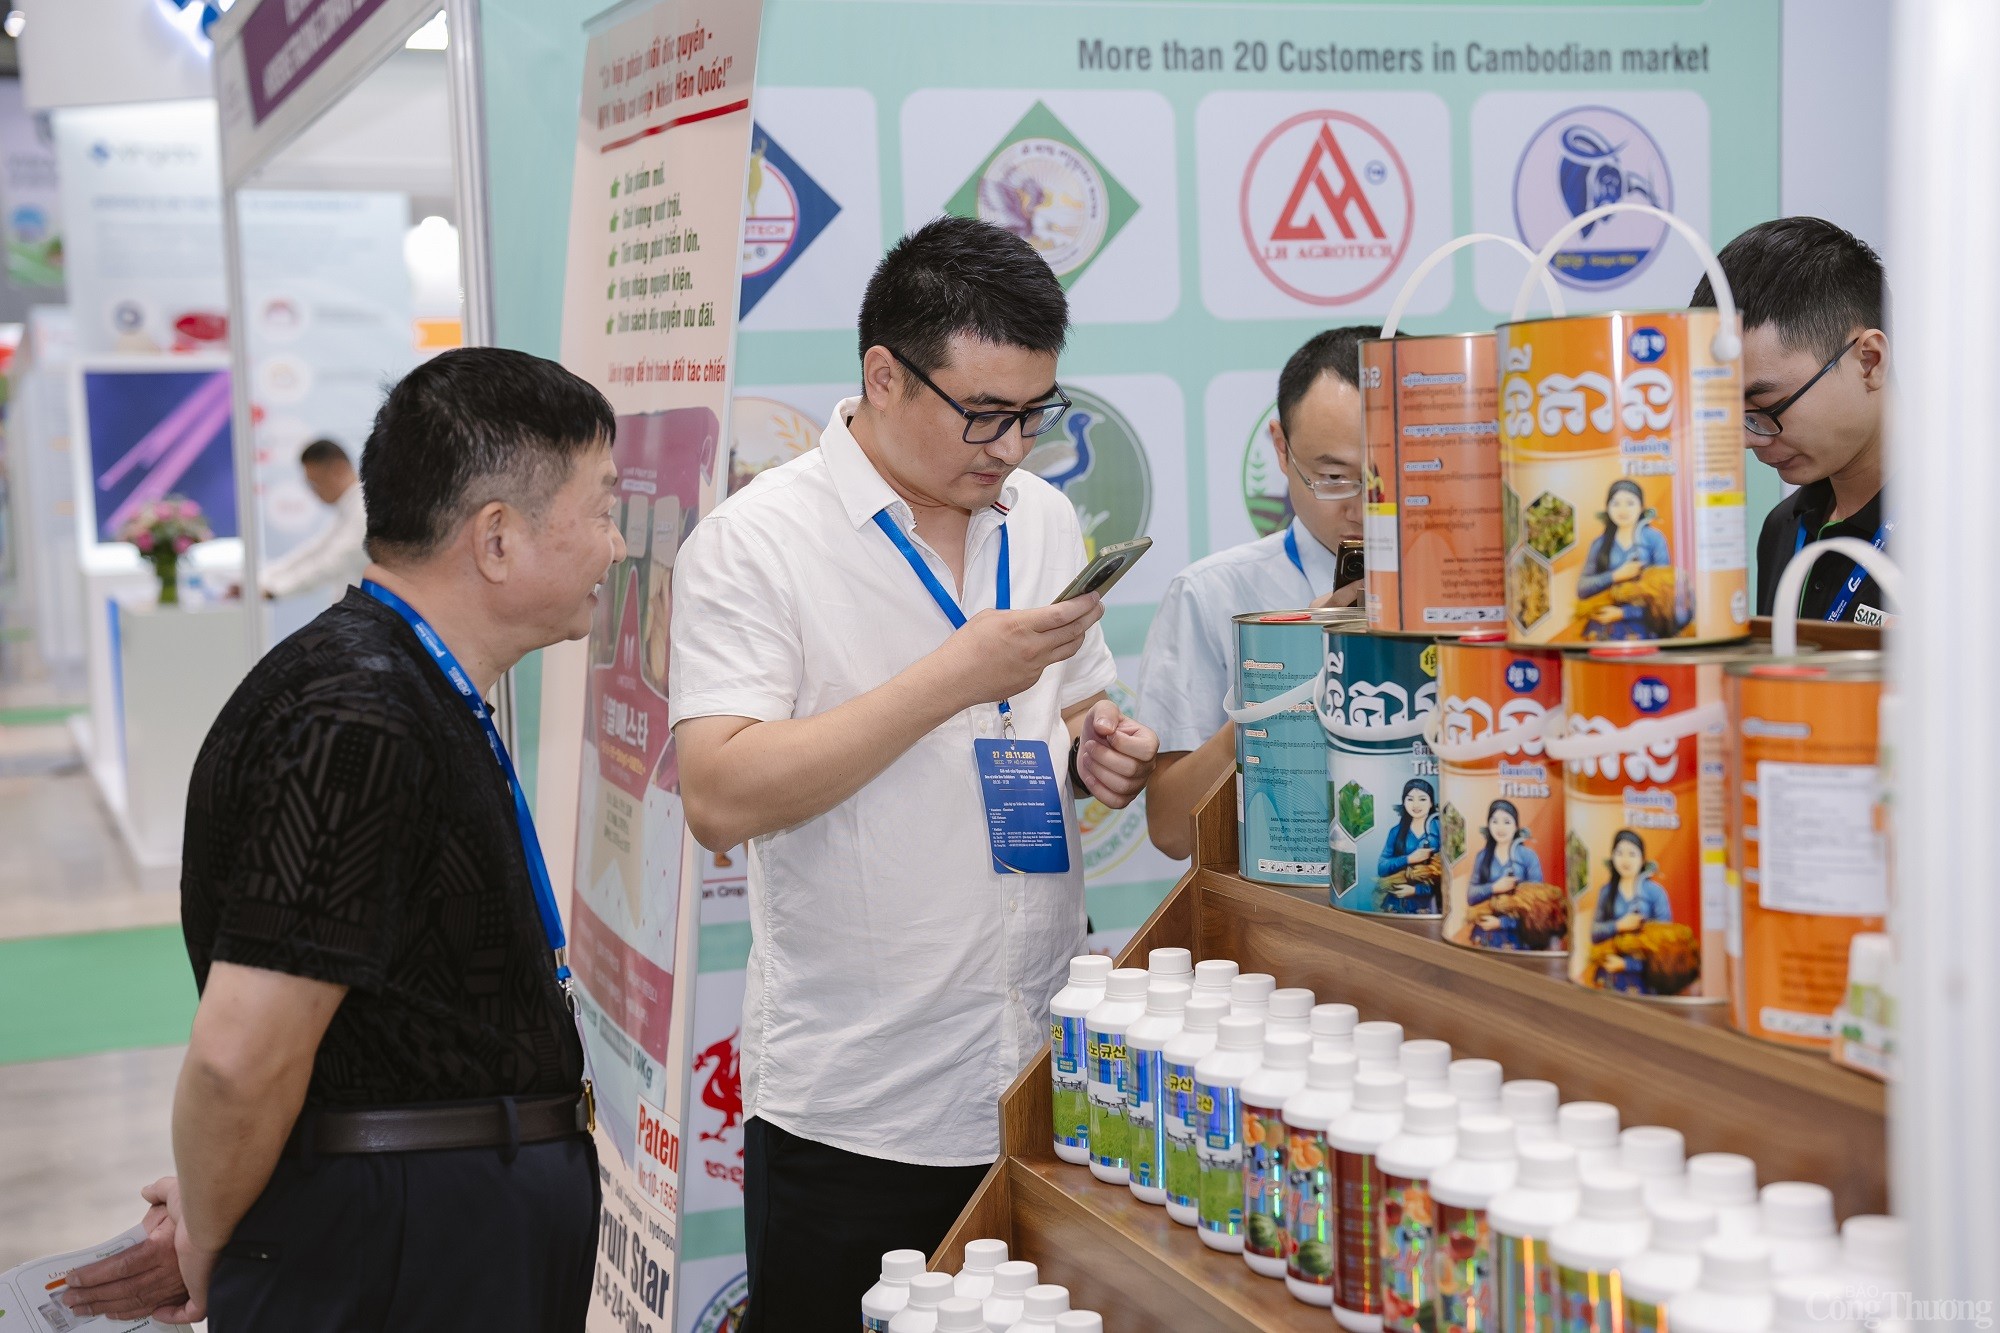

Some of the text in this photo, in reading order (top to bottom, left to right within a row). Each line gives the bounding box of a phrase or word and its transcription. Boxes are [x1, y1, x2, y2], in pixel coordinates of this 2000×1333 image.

[1078, 39, 1709, 73] More than 20 Customers in Cambodian market
[675, 70, 694, 100] Hàn
[683, 227, 700, 253] lớn.
[1265, 244, 1392, 260] LH AGROTECH
[672, 267, 693, 296] kiện.
[698, 302, 715, 327] đãi.
[672, 356, 685, 382] đối
[688, 360, 701, 382] tác
[704, 356, 726, 382] chiến
[1855, 608, 1882, 627] SARA
[1500, 781, 1550, 800] Titans
[601, 1203, 670, 1321] ruit Star
